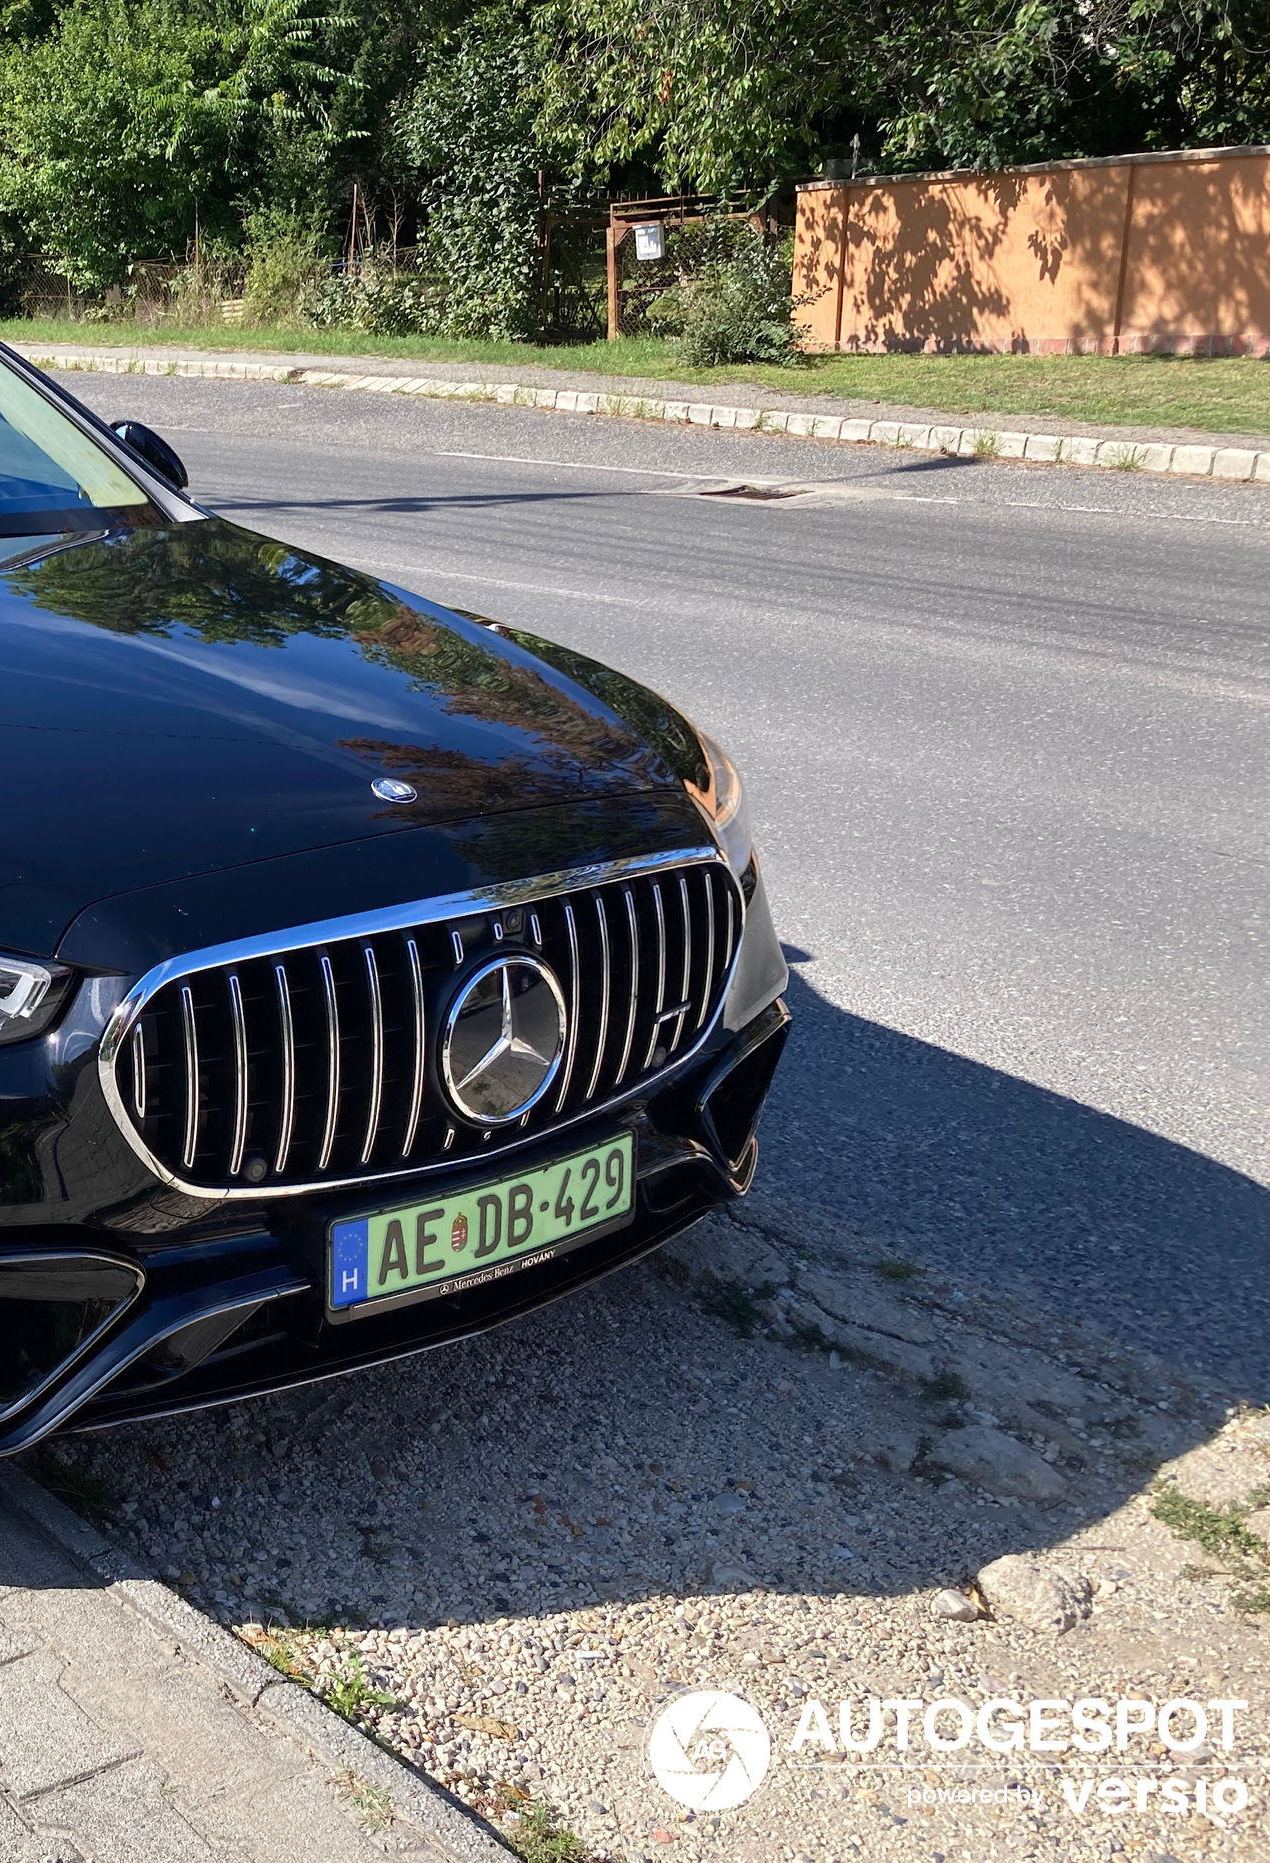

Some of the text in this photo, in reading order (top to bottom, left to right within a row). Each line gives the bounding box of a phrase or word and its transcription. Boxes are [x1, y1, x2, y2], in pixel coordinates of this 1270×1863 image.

[376, 1207, 447, 1286] AE
[341, 1267, 359, 1294] H
[452, 1248, 556, 1292] Mercedes-Benz HOVÁNY
